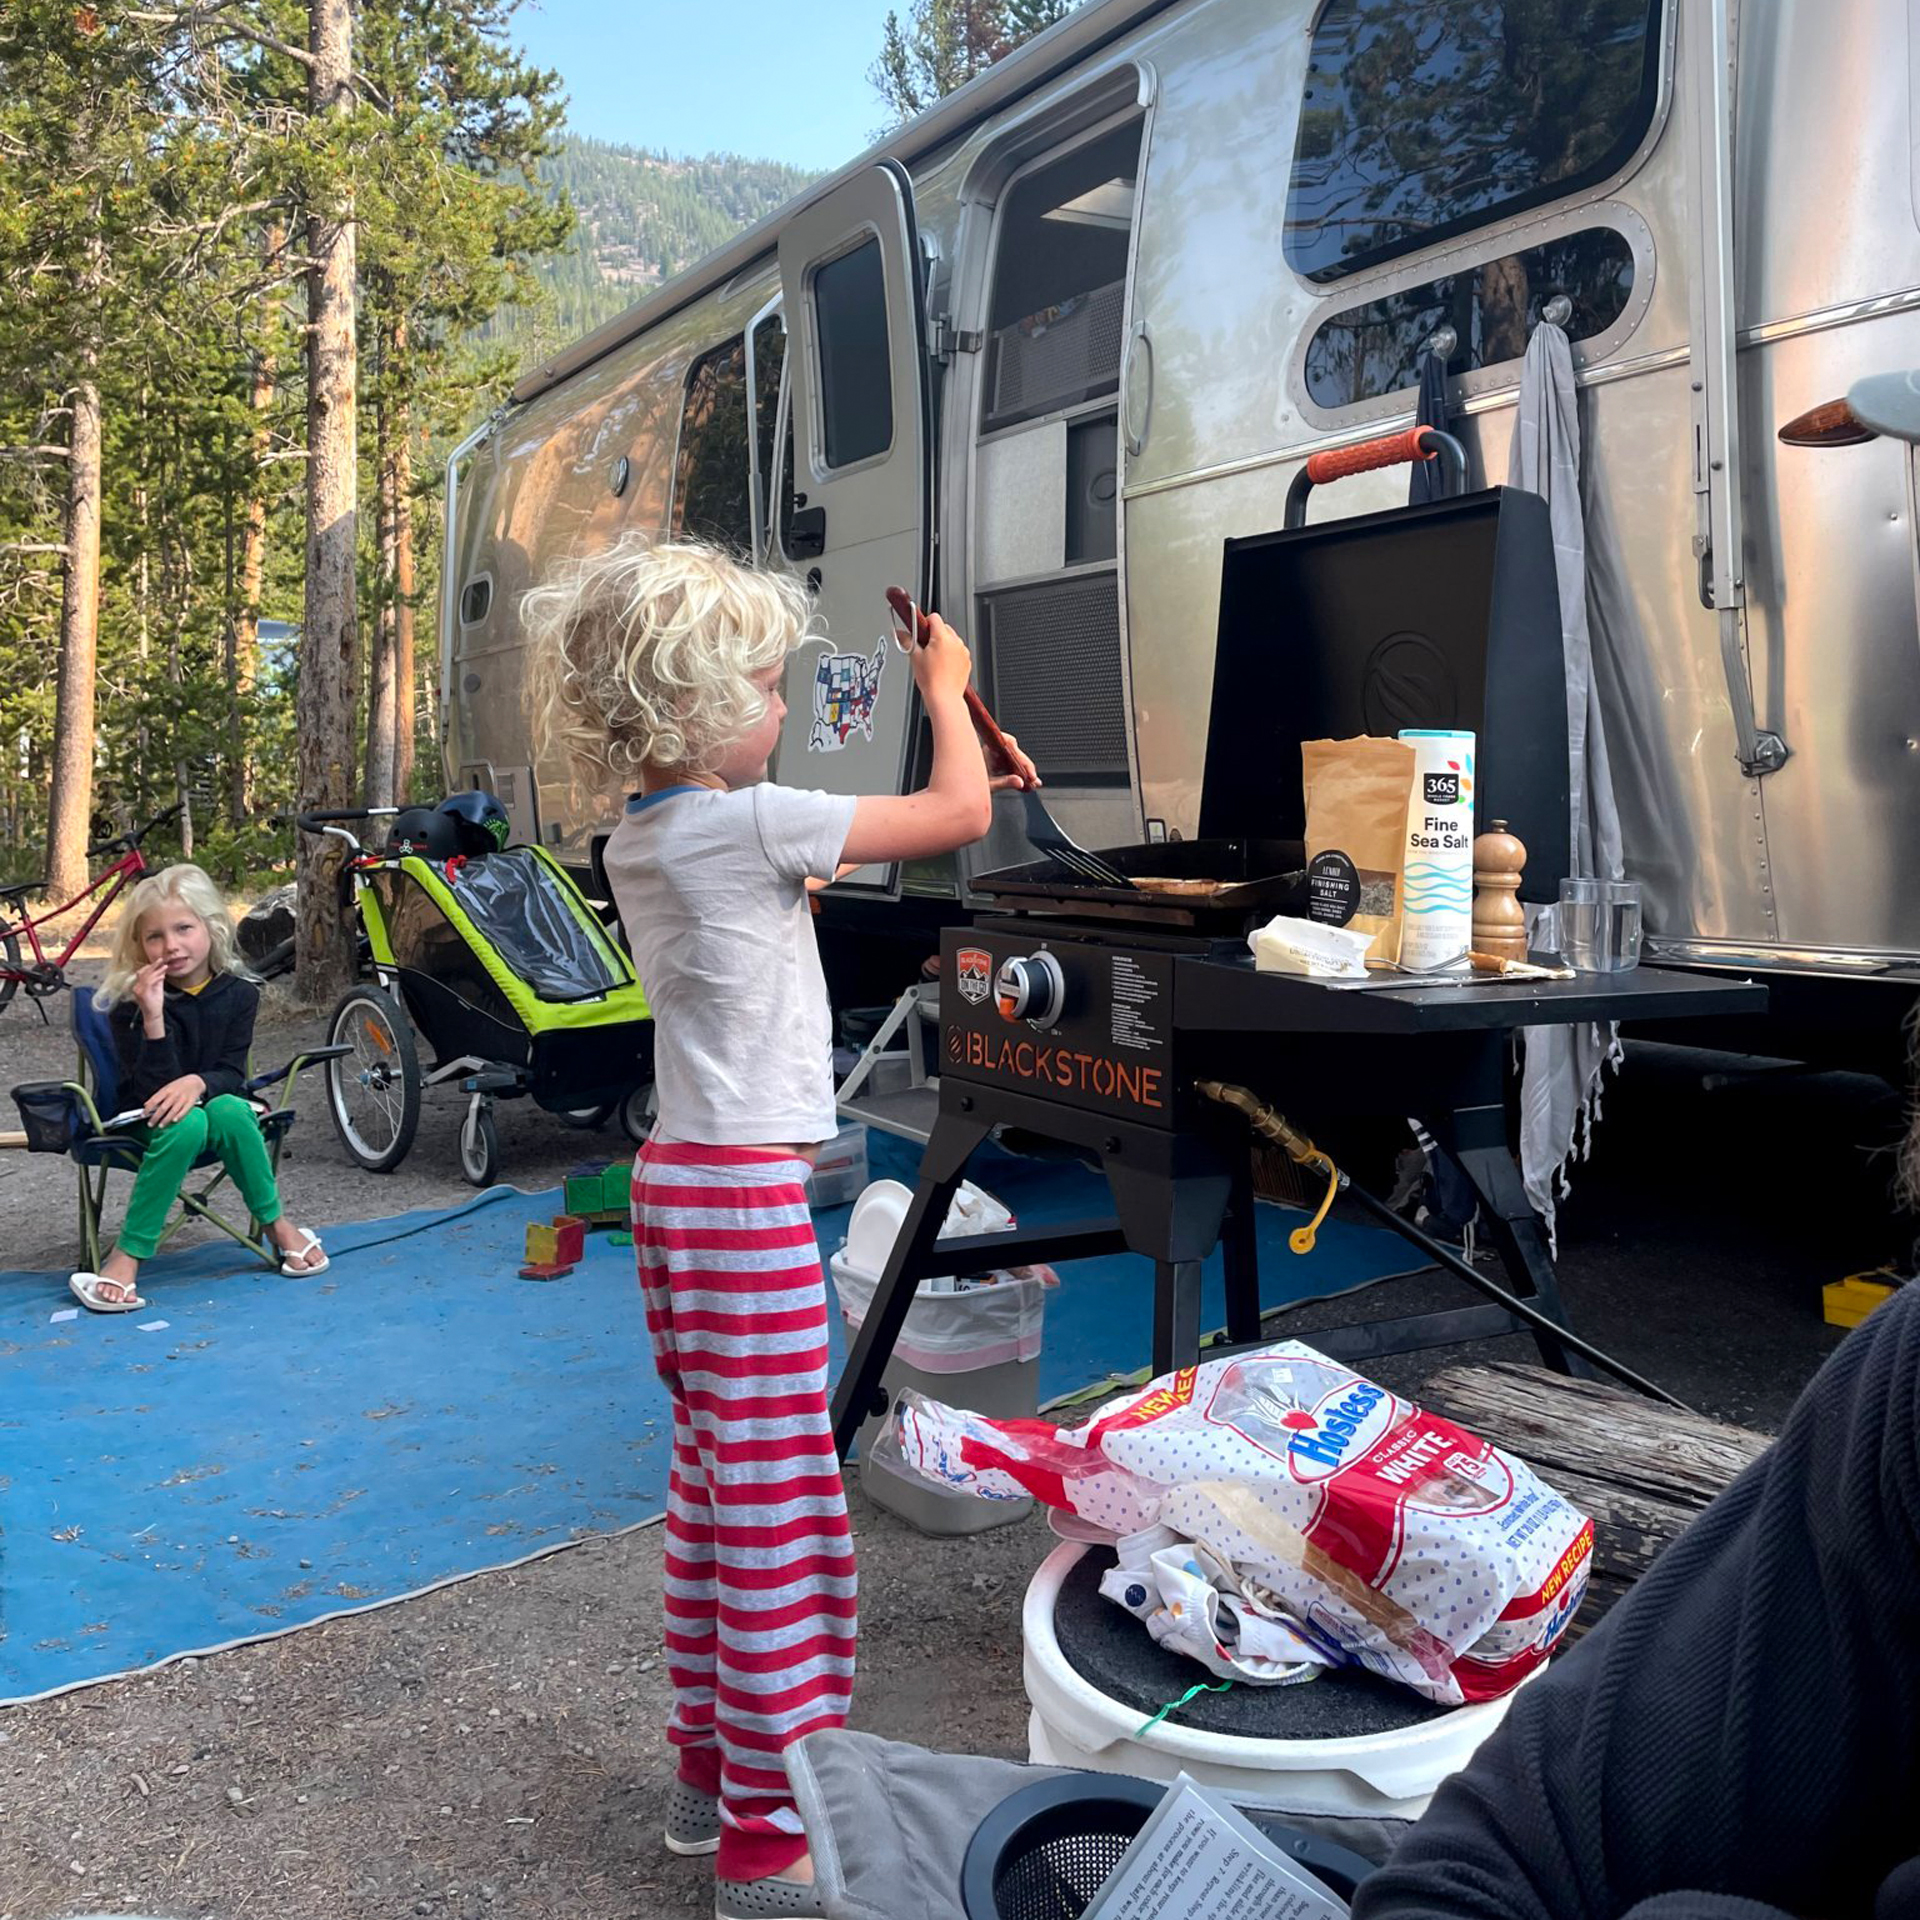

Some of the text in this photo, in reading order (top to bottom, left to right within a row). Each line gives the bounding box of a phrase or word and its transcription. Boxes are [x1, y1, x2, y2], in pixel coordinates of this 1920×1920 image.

[1427, 777, 1456, 793] 365
[1424, 817, 1458, 831] Fine
[1411, 834, 1468, 848] Sea Salt
[1311, 879, 1350, 891] FINISHING
[1320, 889, 1337, 898] SALT
[961, 980, 969, 990] ON
[966, 1032, 1162, 1108] BLACKSTONE
[1130, 1390, 1175, 1421] NEW
[1288, 1383, 1385, 1467] Hostess
[1372, 1430, 1418, 1464] CLASSIC
[1376, 1431, 1454, 1484] WHITE
[1452, 1458, 1478, 1476] 75
[1505, 1535, 1523, 1549] NET
[1541, 1530, 1592, 1604] NEW RECIPE
[1183, 1809, 1196, 1824] the
[1190, 1818, 1205, 1837] rows
[1206, 1828, 1217, 1840] If
[1163, 1821, 1185, 1853] process
[1181, 1835, 1193, 1851] you
[1198, 1834, 1210, 1851] you
[1157, 1852, 1165, 1862] at
[1168, 1849, 1184, 1869] make
[1185, 1850, 1200, 1869] want
[1222, 1848, 1240, 1867] Step
[1141, 1861, 1159, 1884] about
[1161, 1866, 1173, 1880] for
[1179, 1867, 1189, 1877] to
[1224, 1862, 1253, 1899] wrinkling
[1251, 1868, 1266, 1885] flat
[1129, 1883, 1146, 1903] half
[1149, 1878, 1163, 1896] each
[1167, 1875, 1184, 1893] keep
[1199, 1875, 1220, 1901] Repeat
[1241, 1883, 1254, 1900] and
[1156, 1891, 1171, 1911] your
[1215, 1898, 1228, 1912] the
[1246, 1878, 1275, 1915] through to
[1259, 1886, 1287, 1920] than your
[1119, 1900, 1133, 1915] way
[1187, 1900, 1203, 1917] Step
[1230, 1898, 1244, 1916] slide
[1292, 1900, 1310, 1917] Step
